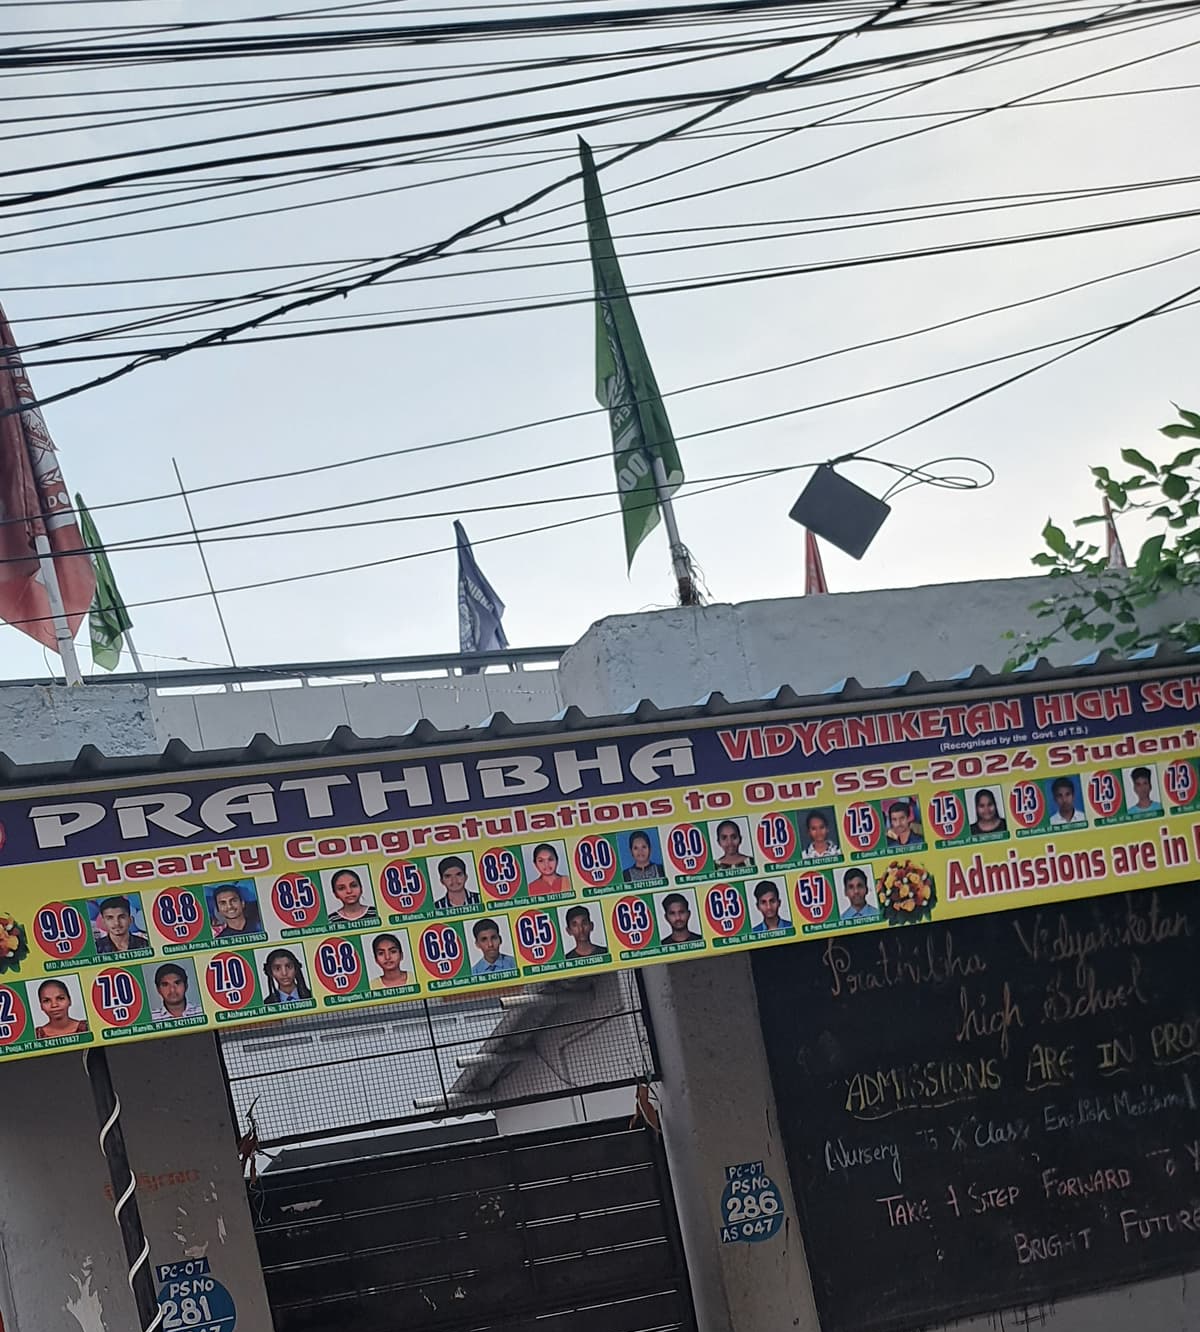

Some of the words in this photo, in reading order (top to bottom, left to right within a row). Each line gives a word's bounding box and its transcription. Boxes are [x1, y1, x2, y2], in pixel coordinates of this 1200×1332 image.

[717, 699, 1024, 762] VIDYANIKETAN
[1033, 685, 1133, 729] HIGH
[940, 736, 997, 752] (Recognised
[999, 735, 1012, 745] by
[1012, 733, 1027, 743] the
[1031, 730, 1056, 740] Govt.
[1057, 728, 1067, 737] of
[1090, 774, 1115, 802] 7.3
[1167, 764, 1190, 790] 7.3
[28, 737, 696, 849] PRATHIBHA
[1012, 785, 1038, 812] 7.3
[81, 845, 271, 886] Hearty
[286, 797, 673, 860] Congratulations
[685, 789, 732, 812] to
[745, 778, 823, 805] Our
[834, 749, 1038, 794] SSC-2024
[846, 806, 874, 835] 7.5
[931, 796, 959, 824] 7.5
[672, 828, 703, 858] 8.0
[759, 818, 789, 847] 7.8
[860, 835, 869, 845] 10
[579, 839, 612, 870] 8.0
[685, 858, 696, 868] 10
[774, 846, 784, 856] 10
[949, 845, 1107, 899] Admissions
[1112, 841, 1157, 874] are
[1160, 827, 1189, 866] in
[385, 864, 421, 896] 8.5
[482, 852, 517, 883] 8.3
[593, 870, 604, 880] 10
[276, 878, 315, 910] 8.5
[400, 896, 412, 906] 10
[497, 883, 509, 893] 10
[797, 875, 827, 906] 5.7
[158, 892, 198, 926] 8.8
[293, 910, 305, 920] 10
[616, 900, 649, 932] 6.3
[709, 888, 741, 919] 6.3
[811, 906, 822, 916] 10
[38, 906, 82, 942] 9.0
[175, 925, 188, 936] 10
[518, 914, 552, 947] 6.5
[630, 932, 641, 943] 10
[723, 919, 733, 930] 10
[58, 941, 72, 952] 10
[423, 928, 458, 961] 6.8
[533, 947, 544, 957] 10
[320, 942, 356, 976] 6.8
[438, 962, 450, 972] 10
[210, 957, 245, 992] 7.0
[335, 976, 348, 988] 10
[96, 972, 134, 1010] 7.0
[227, 991, 240, 1003] 10
[114, 1008, 128, 1020] 10
[845, 1058, 1001, 1111] ADMISSIONS
[1026, 1043, 1076, 1081] ARE
[1096, 1036, 1137, 1067] IN
[1150, 1018, 1200, 1057] PRO
[728, 1162, 763, 1179] PC-07
[824, 1136, 903, 1184] Nursery
[731, 1179, 751, 1195] PS
[726, 1190, 778, 1222] 286
[723, 1226, 739, 1242] AS
[742, 1217, 774, 1236] 047
[160, 1260, 204, 1281] PC-07
[169, 1280, 192, 1298] PS
[161, 1295, 212, 1329] 281
